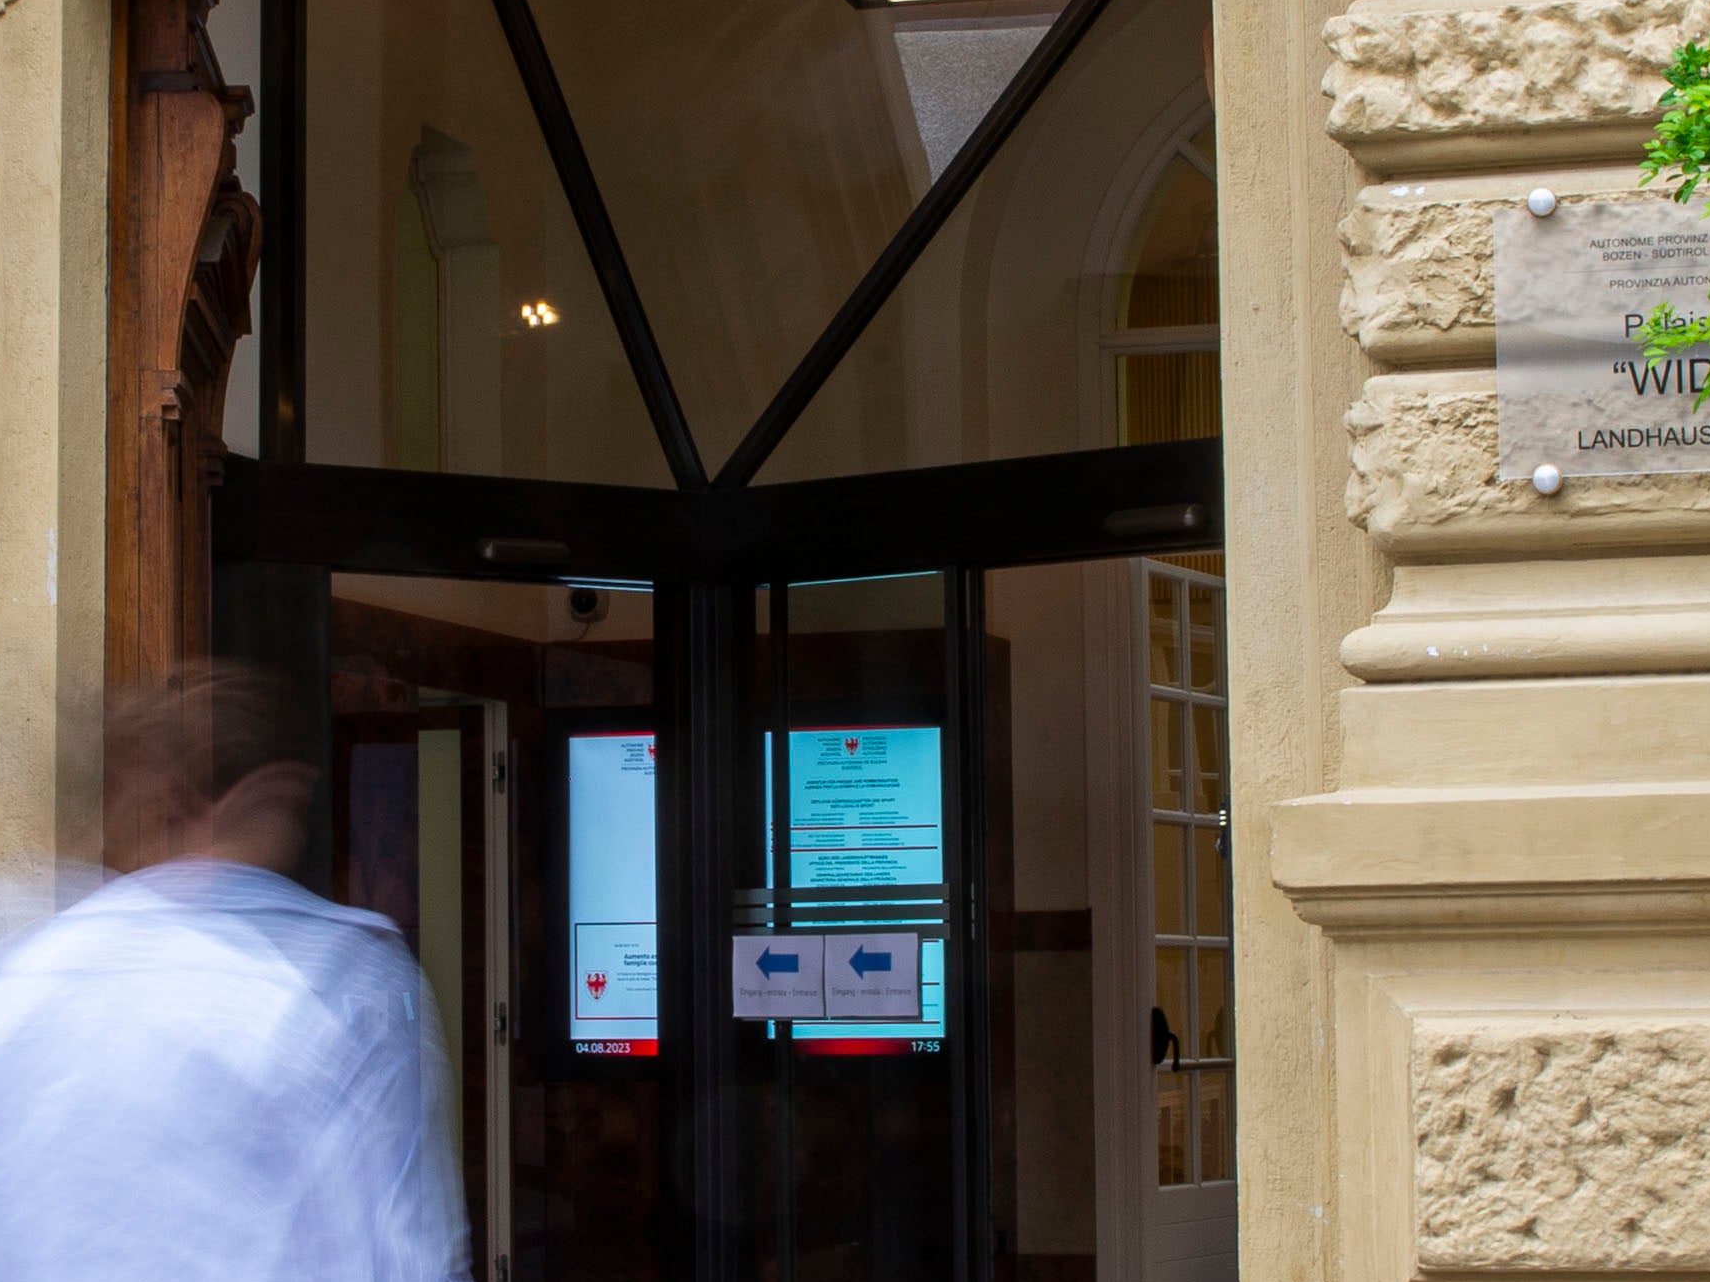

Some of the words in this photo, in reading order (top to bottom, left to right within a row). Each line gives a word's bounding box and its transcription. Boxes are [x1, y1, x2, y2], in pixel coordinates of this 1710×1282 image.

[1589, 236, 1654, 249] AUTONOME
[1657, 233, 1709, 246] PROVINZ
[1602, 250, 1641, 261] BOZEN
[1651, 247, 1709, 259] SÜDTIROL
[1609, 278, 1670, 289] PROVINZIA
[1624, 311, 1708, 338] Plais
[576, 1042, 631, 1054] 04.08.2023
[911, 1041, 940, 1052] 17:55
